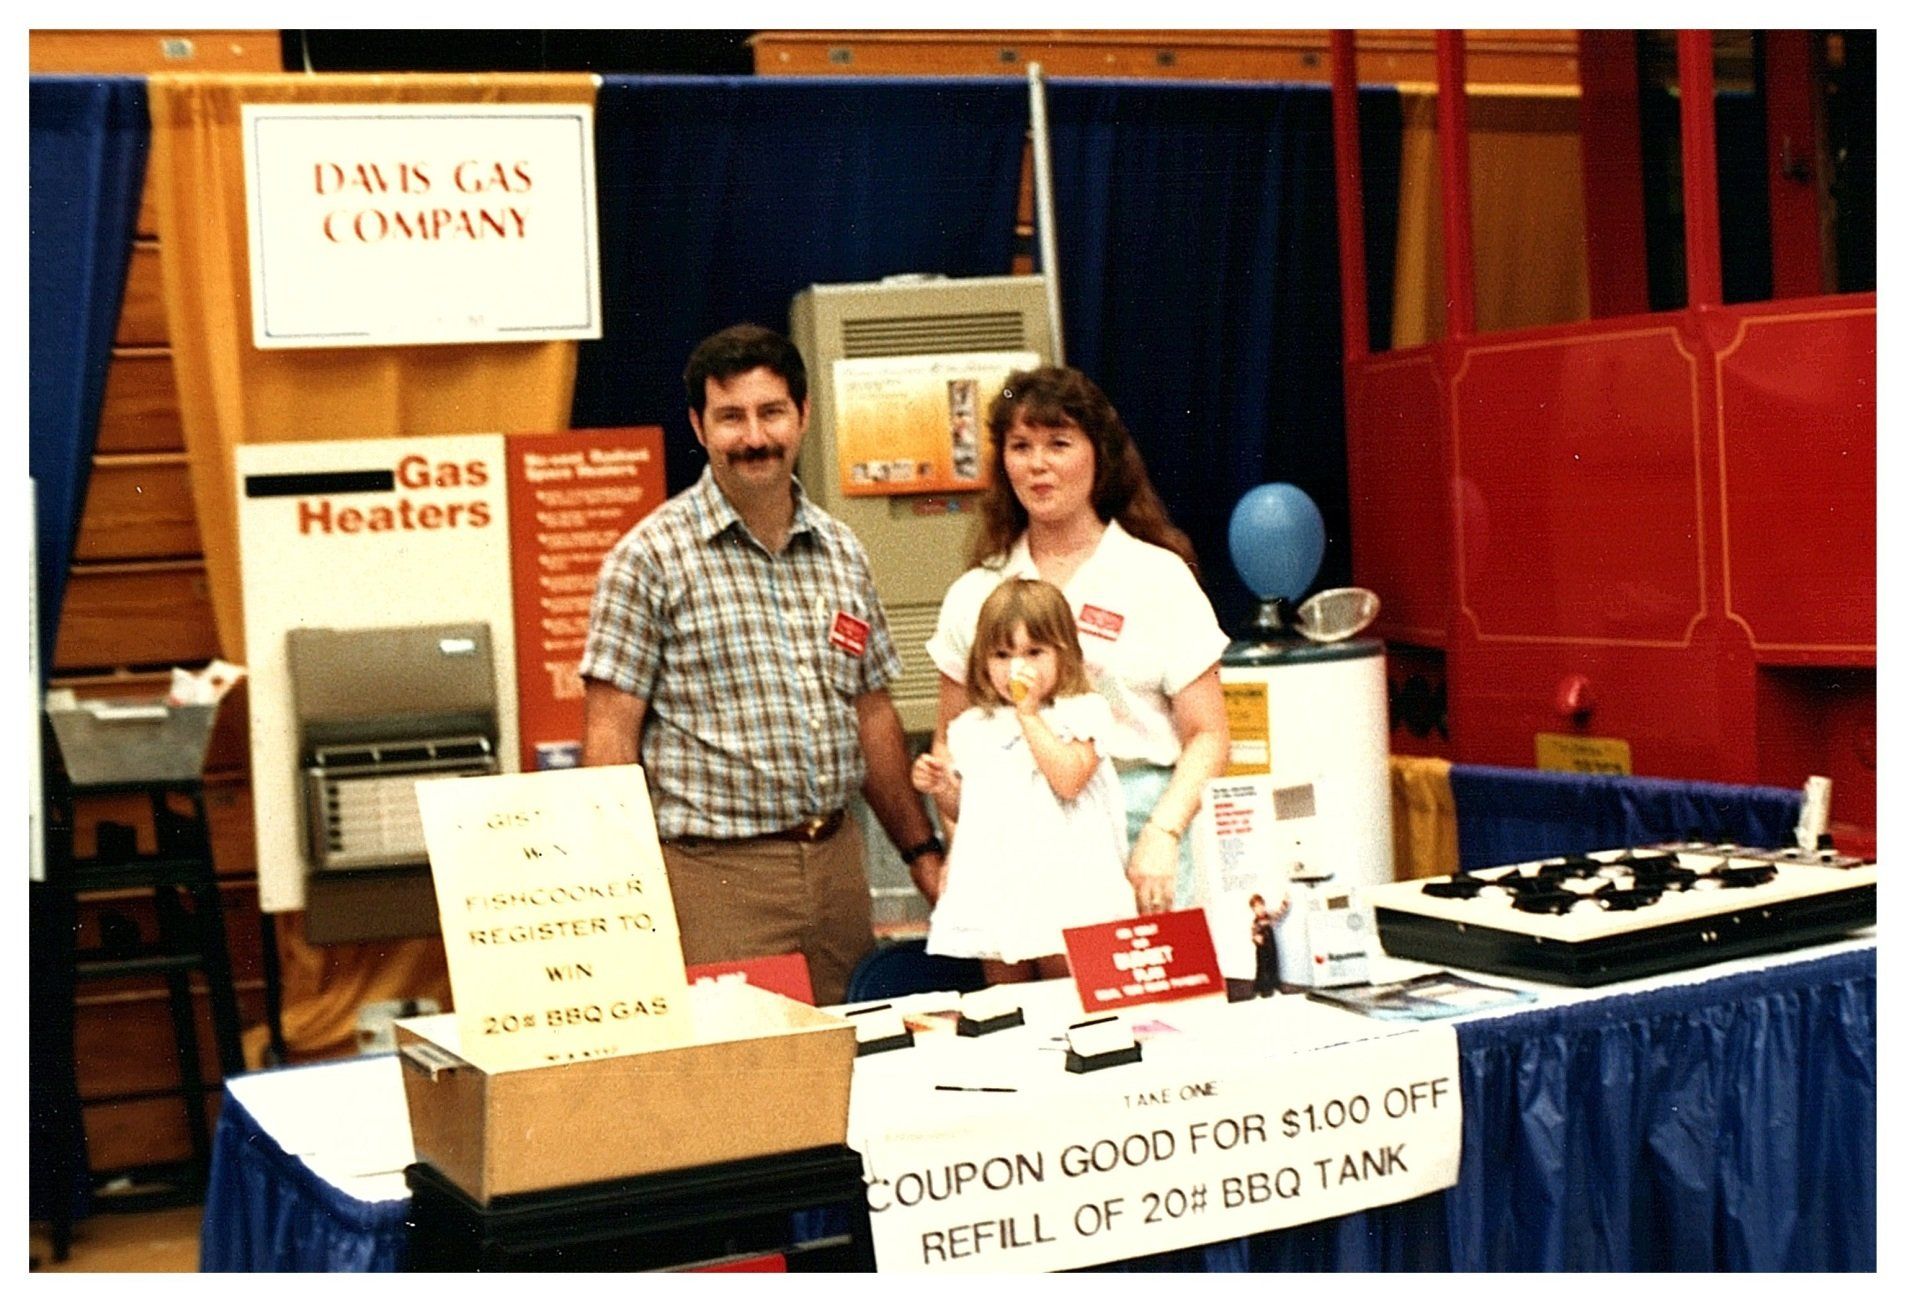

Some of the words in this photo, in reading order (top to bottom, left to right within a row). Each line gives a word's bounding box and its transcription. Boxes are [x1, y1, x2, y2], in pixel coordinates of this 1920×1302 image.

[313, 161, 431, 195] DAVIS
[454, 159, 533, 193] GAS
[322, 206, 530, 243] COMPANY
[396, 453, 490, 489] Gas
[297, 497, 492, 536] Heaters
[465, 878, 644, 912] FISHCOOKER
[468, 916, 608, 945] REGISTER
[618, 912, 653, 932] TO
[545, 962, 593, 983] WIN
[546, 1004, 604, 1027] BBQ
[610, 996, 670, 1020] GAS
[1123, 1090, 1171, 1109] TAKE
[1179, 1081, 1218, 1102] ONE
[866, 1150, 1045, 1213] COUPON
[1060, 1129, 1176, 1179] GOOD
[1190, 1112, 1267, 1155] FOR
[1280, 1093, 1371, 1141] $1.00
[1382, 1077, 1450, 1120] OFF
[920, 1210, 1056, 1265] REFILL
[1074, 1198, 1126, 1237] OF
[1143, 1184, 1209, 1226] 20#
[1221, 1166, 1301, 1210] BBQ
[1312, 1143, 1410, 1190] TANK
